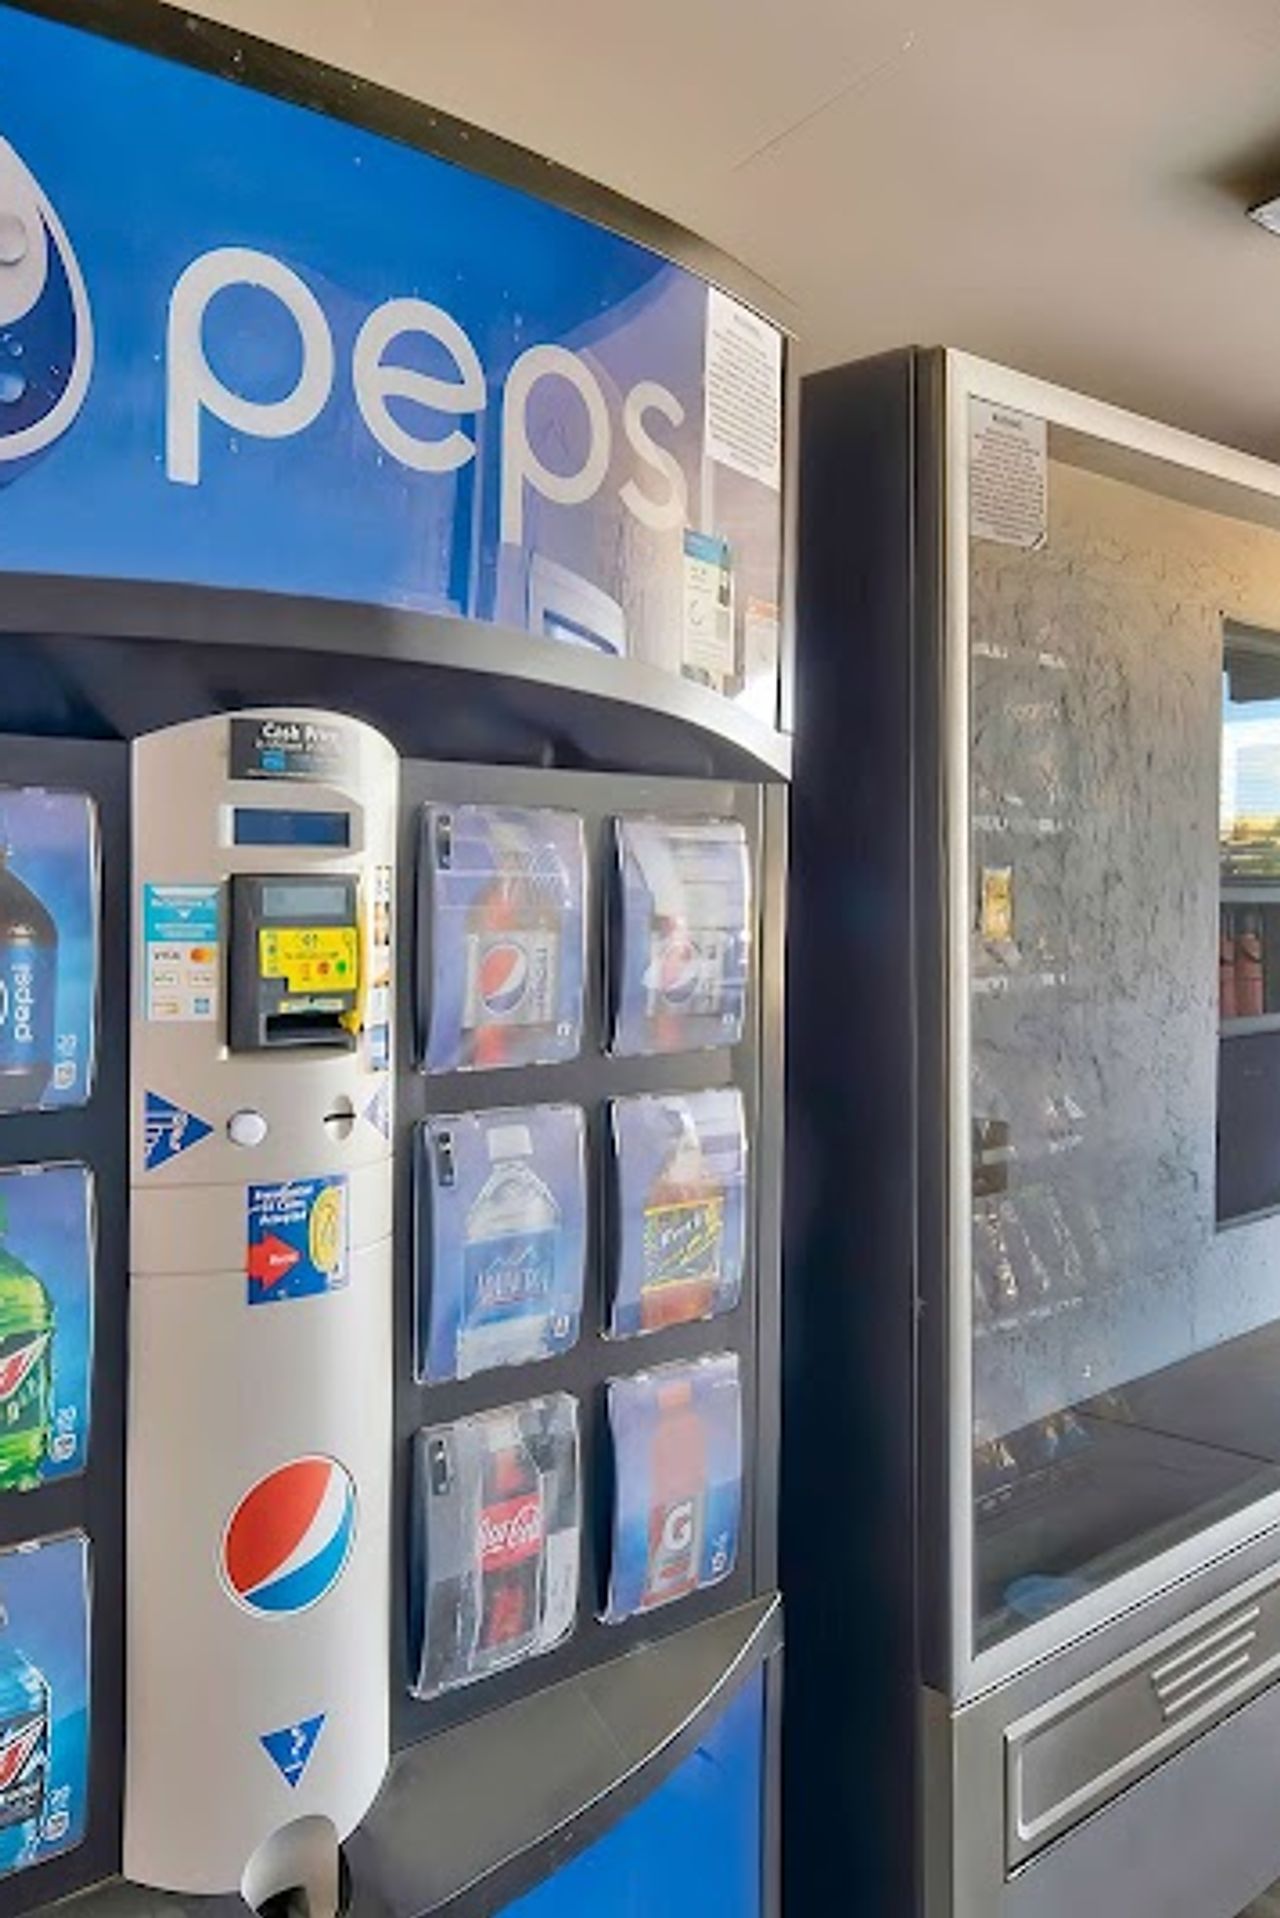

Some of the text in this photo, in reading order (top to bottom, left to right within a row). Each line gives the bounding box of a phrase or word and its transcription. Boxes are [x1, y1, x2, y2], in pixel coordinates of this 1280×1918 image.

[261, 721, 300, 743] Cash
[12, 962, 34, 1044] pepsi
[664, 1500, 693, 1551] G
